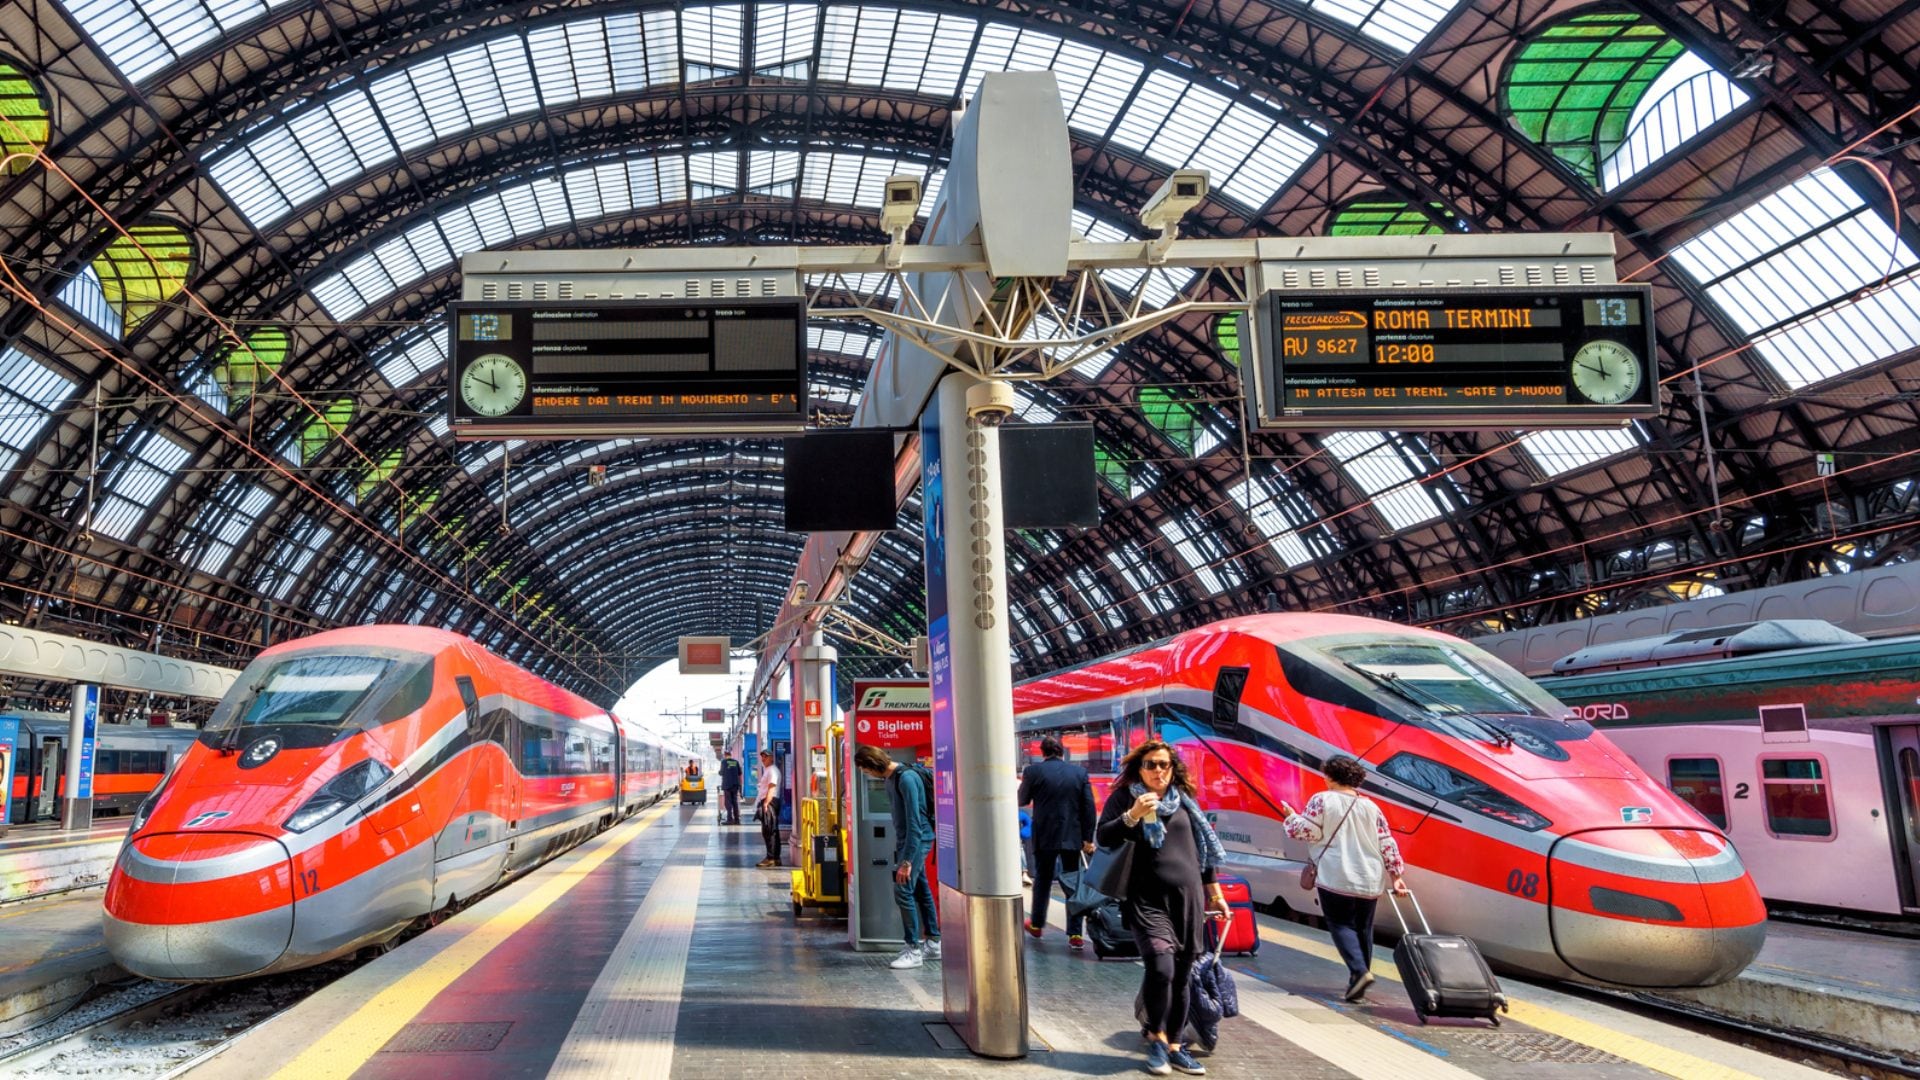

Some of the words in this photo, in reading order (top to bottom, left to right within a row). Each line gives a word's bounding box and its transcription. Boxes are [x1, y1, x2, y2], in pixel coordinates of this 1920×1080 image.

[1373, 298, 1416, 307] destinazione
[531, 311, 572, 319] destinazione
[1374, 309, 1431, 330] ROMA
[1444, 308, 1533, 329] TERMINI
[1595, 299, 1627, 326] 13
[1285, 314, 1351, 325] FRECCIAROSSA
[471, 314, 499, 341] 12
[1375, 334, 1407, 342] partenza
[1407, 334, 1435, 342] departure
[531, 345, 562, 353] partenza
[562, 344, 588, 352] departure
[1284, 337, 1309, 357] AV
[1316, 338, 1359, 354] 9627
[1376, 344, 1436, 365] 12:00
[1284, 376, 1328, 385] informazioni
[1328, 377, 1357, 385] information
[531, 386, 572, 394] informazioni
[1295, 388, 1310, 399] IN
[1316, 387, 1367, 399] ATTESA
[1373, 387, 1397, 398] DEI
[533, 396, 581, 408] ENDERE
[587, 396, 610, 407] DAI
[616, 395, 654, 407] TRENI
[660, 395, 675, 406] IN
[680, 394, 750, 406] MOVIMENTO
[877, 720, 923, 732] Biglietti
[1734, 782, 1749, 799] 2
[300, 869, 320, 894] 12
[1507, 869, 1539, 898] 08
